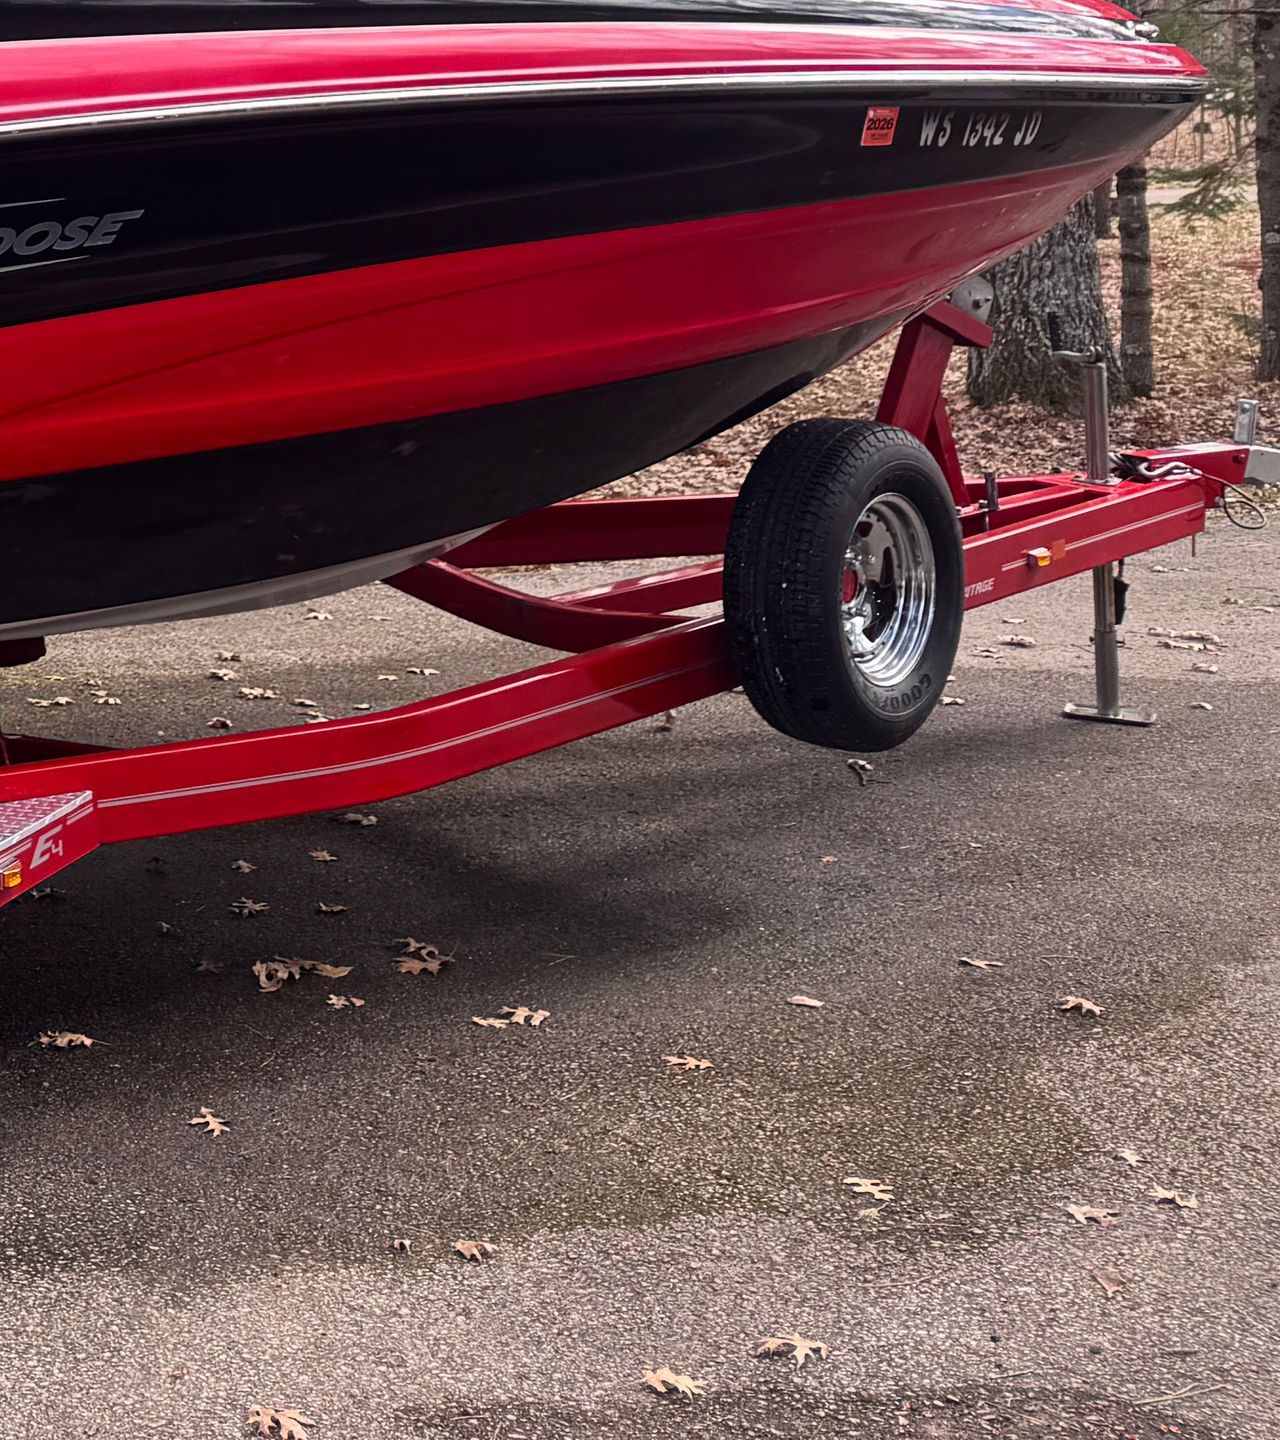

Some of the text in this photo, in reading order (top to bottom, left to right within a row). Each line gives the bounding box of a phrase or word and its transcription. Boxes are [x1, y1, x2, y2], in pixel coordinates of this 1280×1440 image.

[866, 117, 894, 131] 2026
[919, 110, 1042, 147] WS 1342 JD
[964, 577, 995, 598] ITAGE
